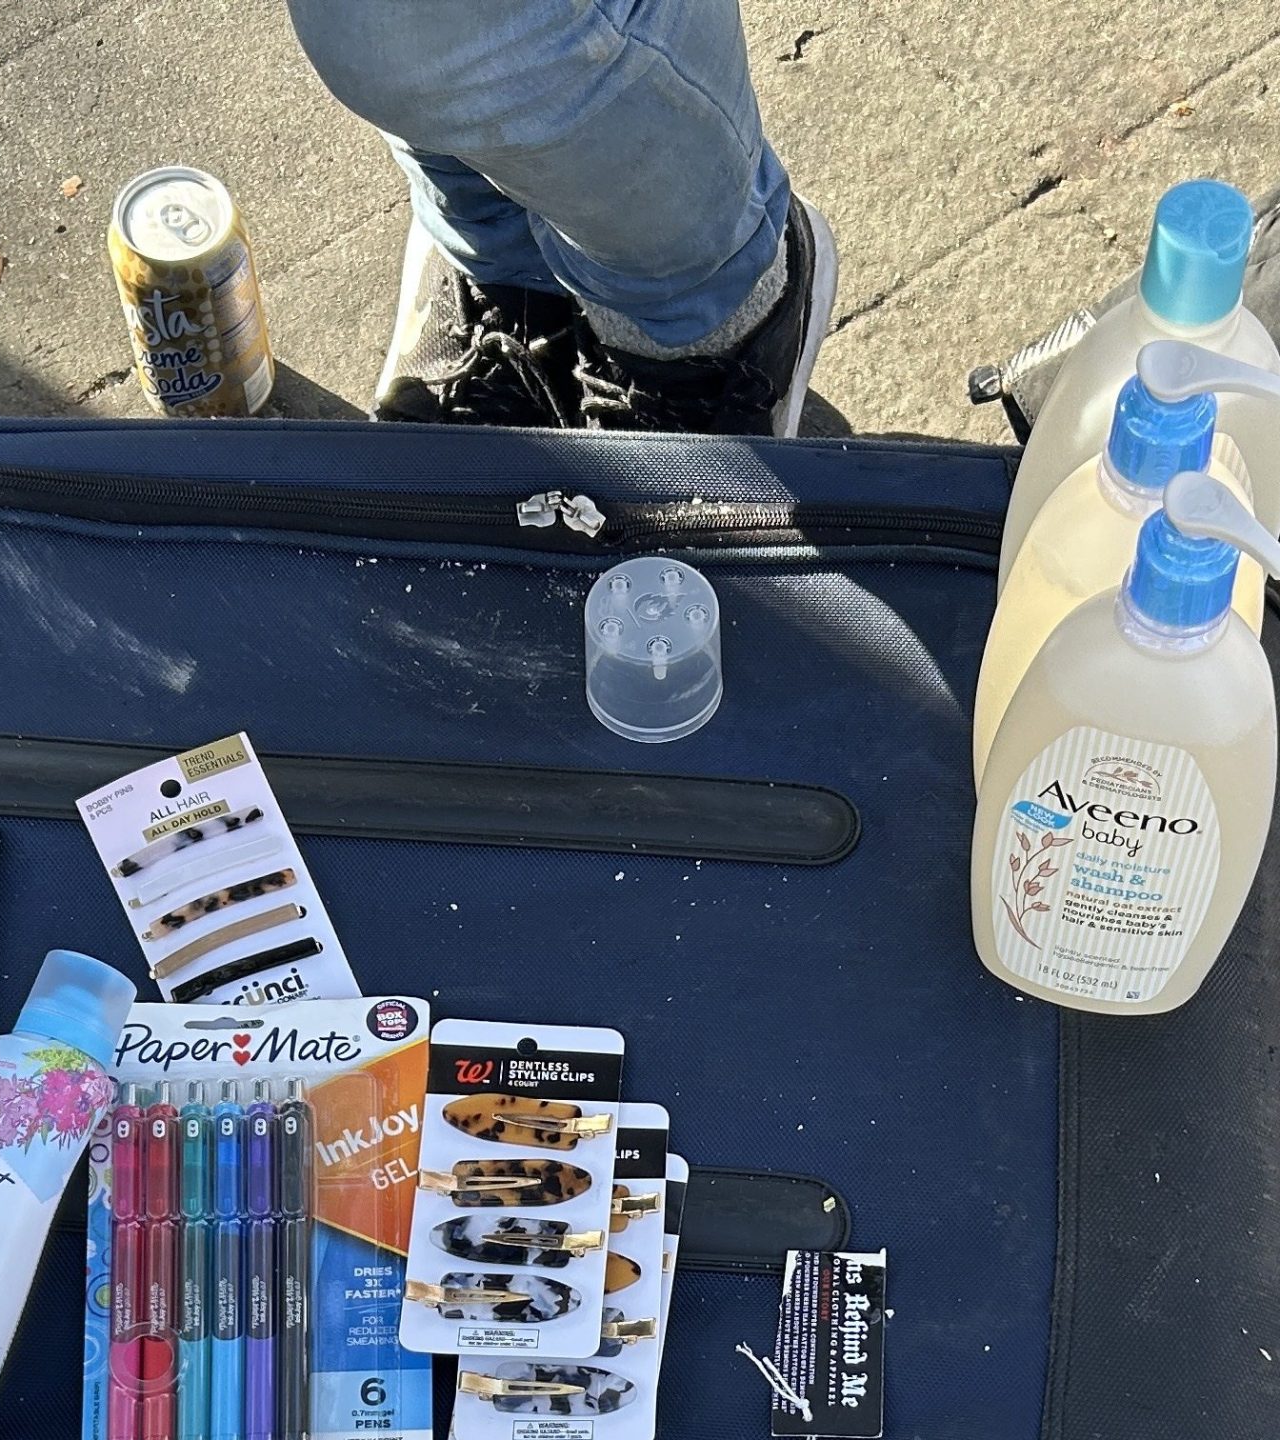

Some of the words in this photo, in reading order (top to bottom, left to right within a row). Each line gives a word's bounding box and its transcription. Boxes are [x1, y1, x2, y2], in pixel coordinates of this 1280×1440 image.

[143, 366, 221, 395] Soda
[184, 749, 215, 768] TREND
[188, 751, 244, 778] ESSENTIALS
[1091, 756, 1152, 771] RECOMMENDED
[1089, 781, 1161, 801] DERMATOLOGISTS
[1091, 777, 1152, 794] PEDIATRICIANS
[149, 806, 176, 823] ALL
[178, 791, 211, 813] HAIR
[1028, 803, 1055, 819] NEW
[1038, 780, 1198, 835] Aveeno
[151, 826, 171, 838] ALL
[171, 816, 191, 831] DAY
[193, 805, 222, 823] HOLD
[1027, 810, 1056, 828] LOOK
[1082, 822, 1144, 857] baby
[1076, 852, 1107, 866] daily
[1111, 861, 1171, 874] moisture
[1073, 864, 1124, 883] wash
[1129, 874, 1147, 886] &
[1070, 877, 1163, 901] shampoo
[1065, 899, 1104, 914] gently
[1107, 909, 1160, 921] cleanses
[1066, 891, 1109, 906] natural
[1137, 905, 1182, 913] extract
[1061, 913, 1085, 926] hair
[1100, 924, 1154, 936] sensitive
[1063, 907, 1122, 925] nourishes
[1125, 920, 1167, 929] baby's
[1037, 962, 1050, 973] 18
[1051, 965, 1061, 976] FL
[1062, 970, 1075, 981] OZ
[1077, 972, 1100, 987] (532
[376, 1011, 403, 1021] BOX
[381, 1018, 408, 1026] TOPS
[115, 1023, 233, 1072] Paper
[251, 1027, 358, 1062] Mate
[508, 1070, 558, 1082] STYLING
[560, 1072, 595, 1082] CLIPS
[509, 1060, 569, 1072] DENTLESS
[315, 1104, 420, 1167] InkJoy
[372, 1158, 419, 1191] GEL
[354, 1266, 392, 1277] DRIES
[822, 1269, 830, 1289] OUR
[821, 1291, 829, 1321] STORY
[362, 1316, 383, 1325] FOR
[830, 1290, 839, 1346] CLOTHING
[838, 1293, 871, 1365] Behind
[346, 1336, 398, 1346] SMEARING
[349, 1326, 397, 1335] REDUCED
[808, 1334, 816, 1385] CONVERSATION
[360, 1377, 387, 1406] 6
[828, 1359, 837, 1406] APPAREL
[840, 1372, 868, 1408] Me
[355, 1419, 391, 1429] PENS
